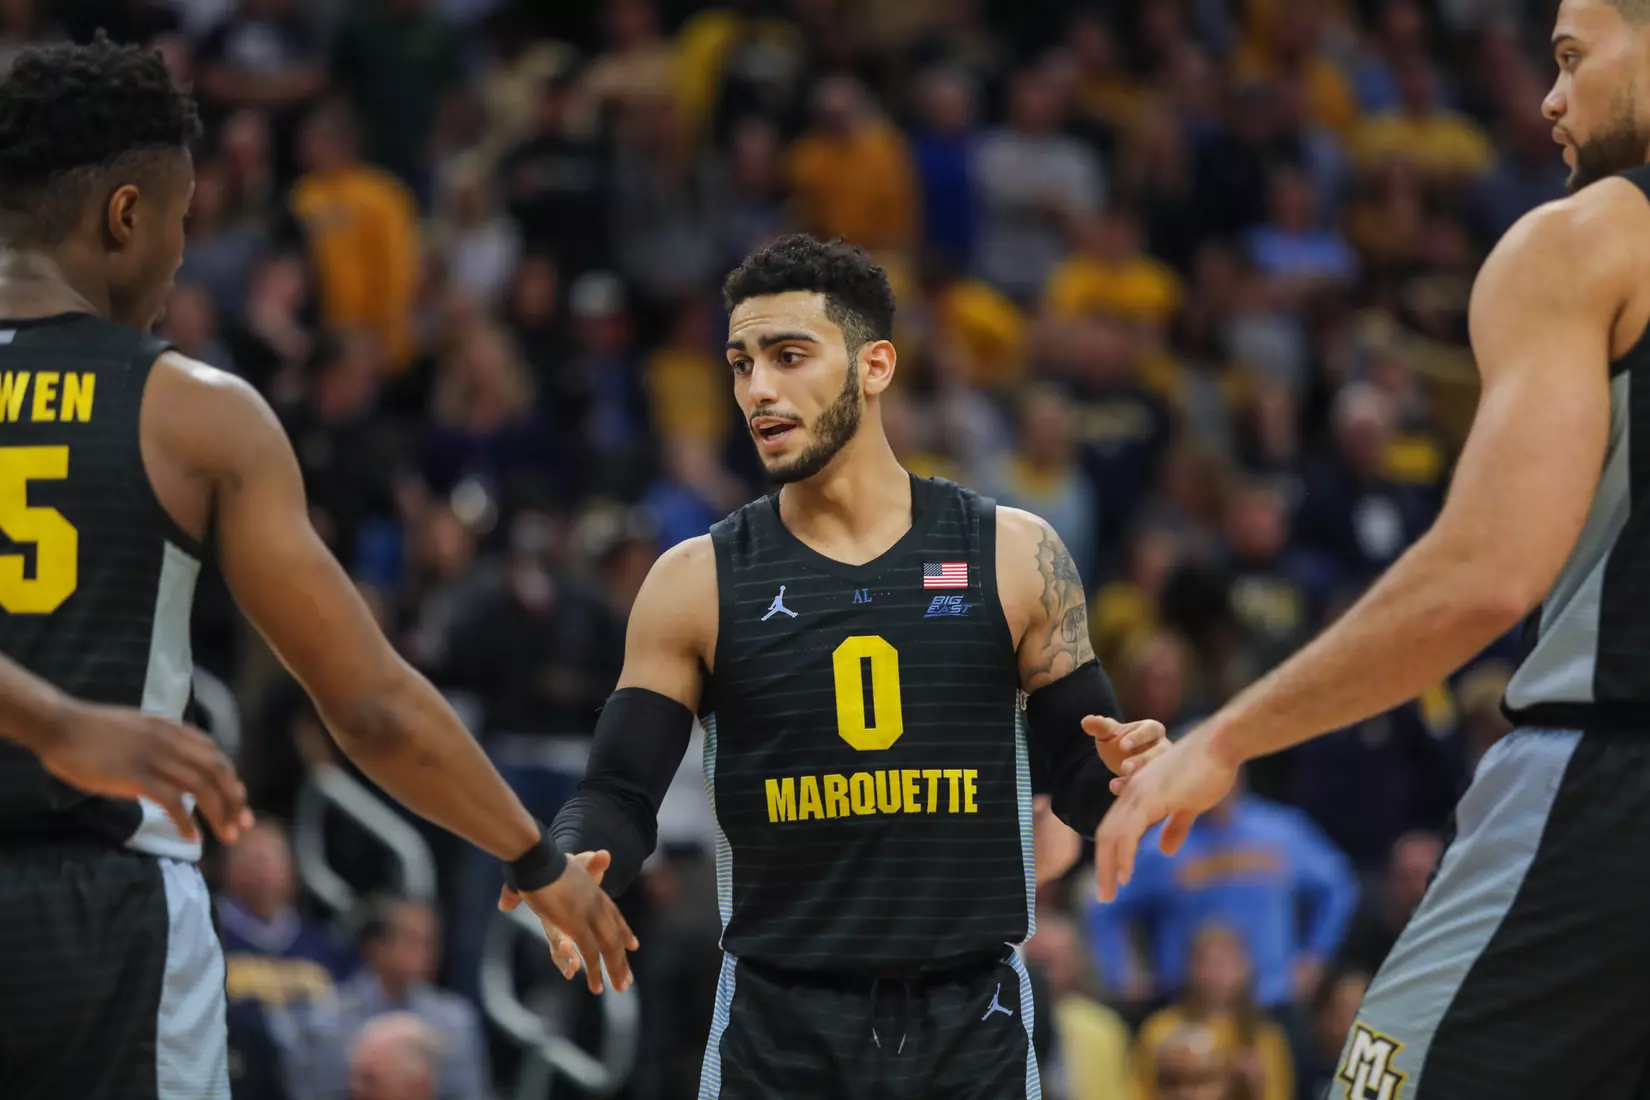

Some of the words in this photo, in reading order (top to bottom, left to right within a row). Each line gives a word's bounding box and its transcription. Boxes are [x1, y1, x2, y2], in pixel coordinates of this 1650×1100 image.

[0, 370, 96, 423] WEN
[0, 445, 78, 614] 5
[852, 588, 872, 604] AL
[926, 604, 973, 614] EAST
[931, 595, 965, 605] BIG
[832, 635, 904, 751] 0
[765, 769, 978, 823] MARQUETTE
